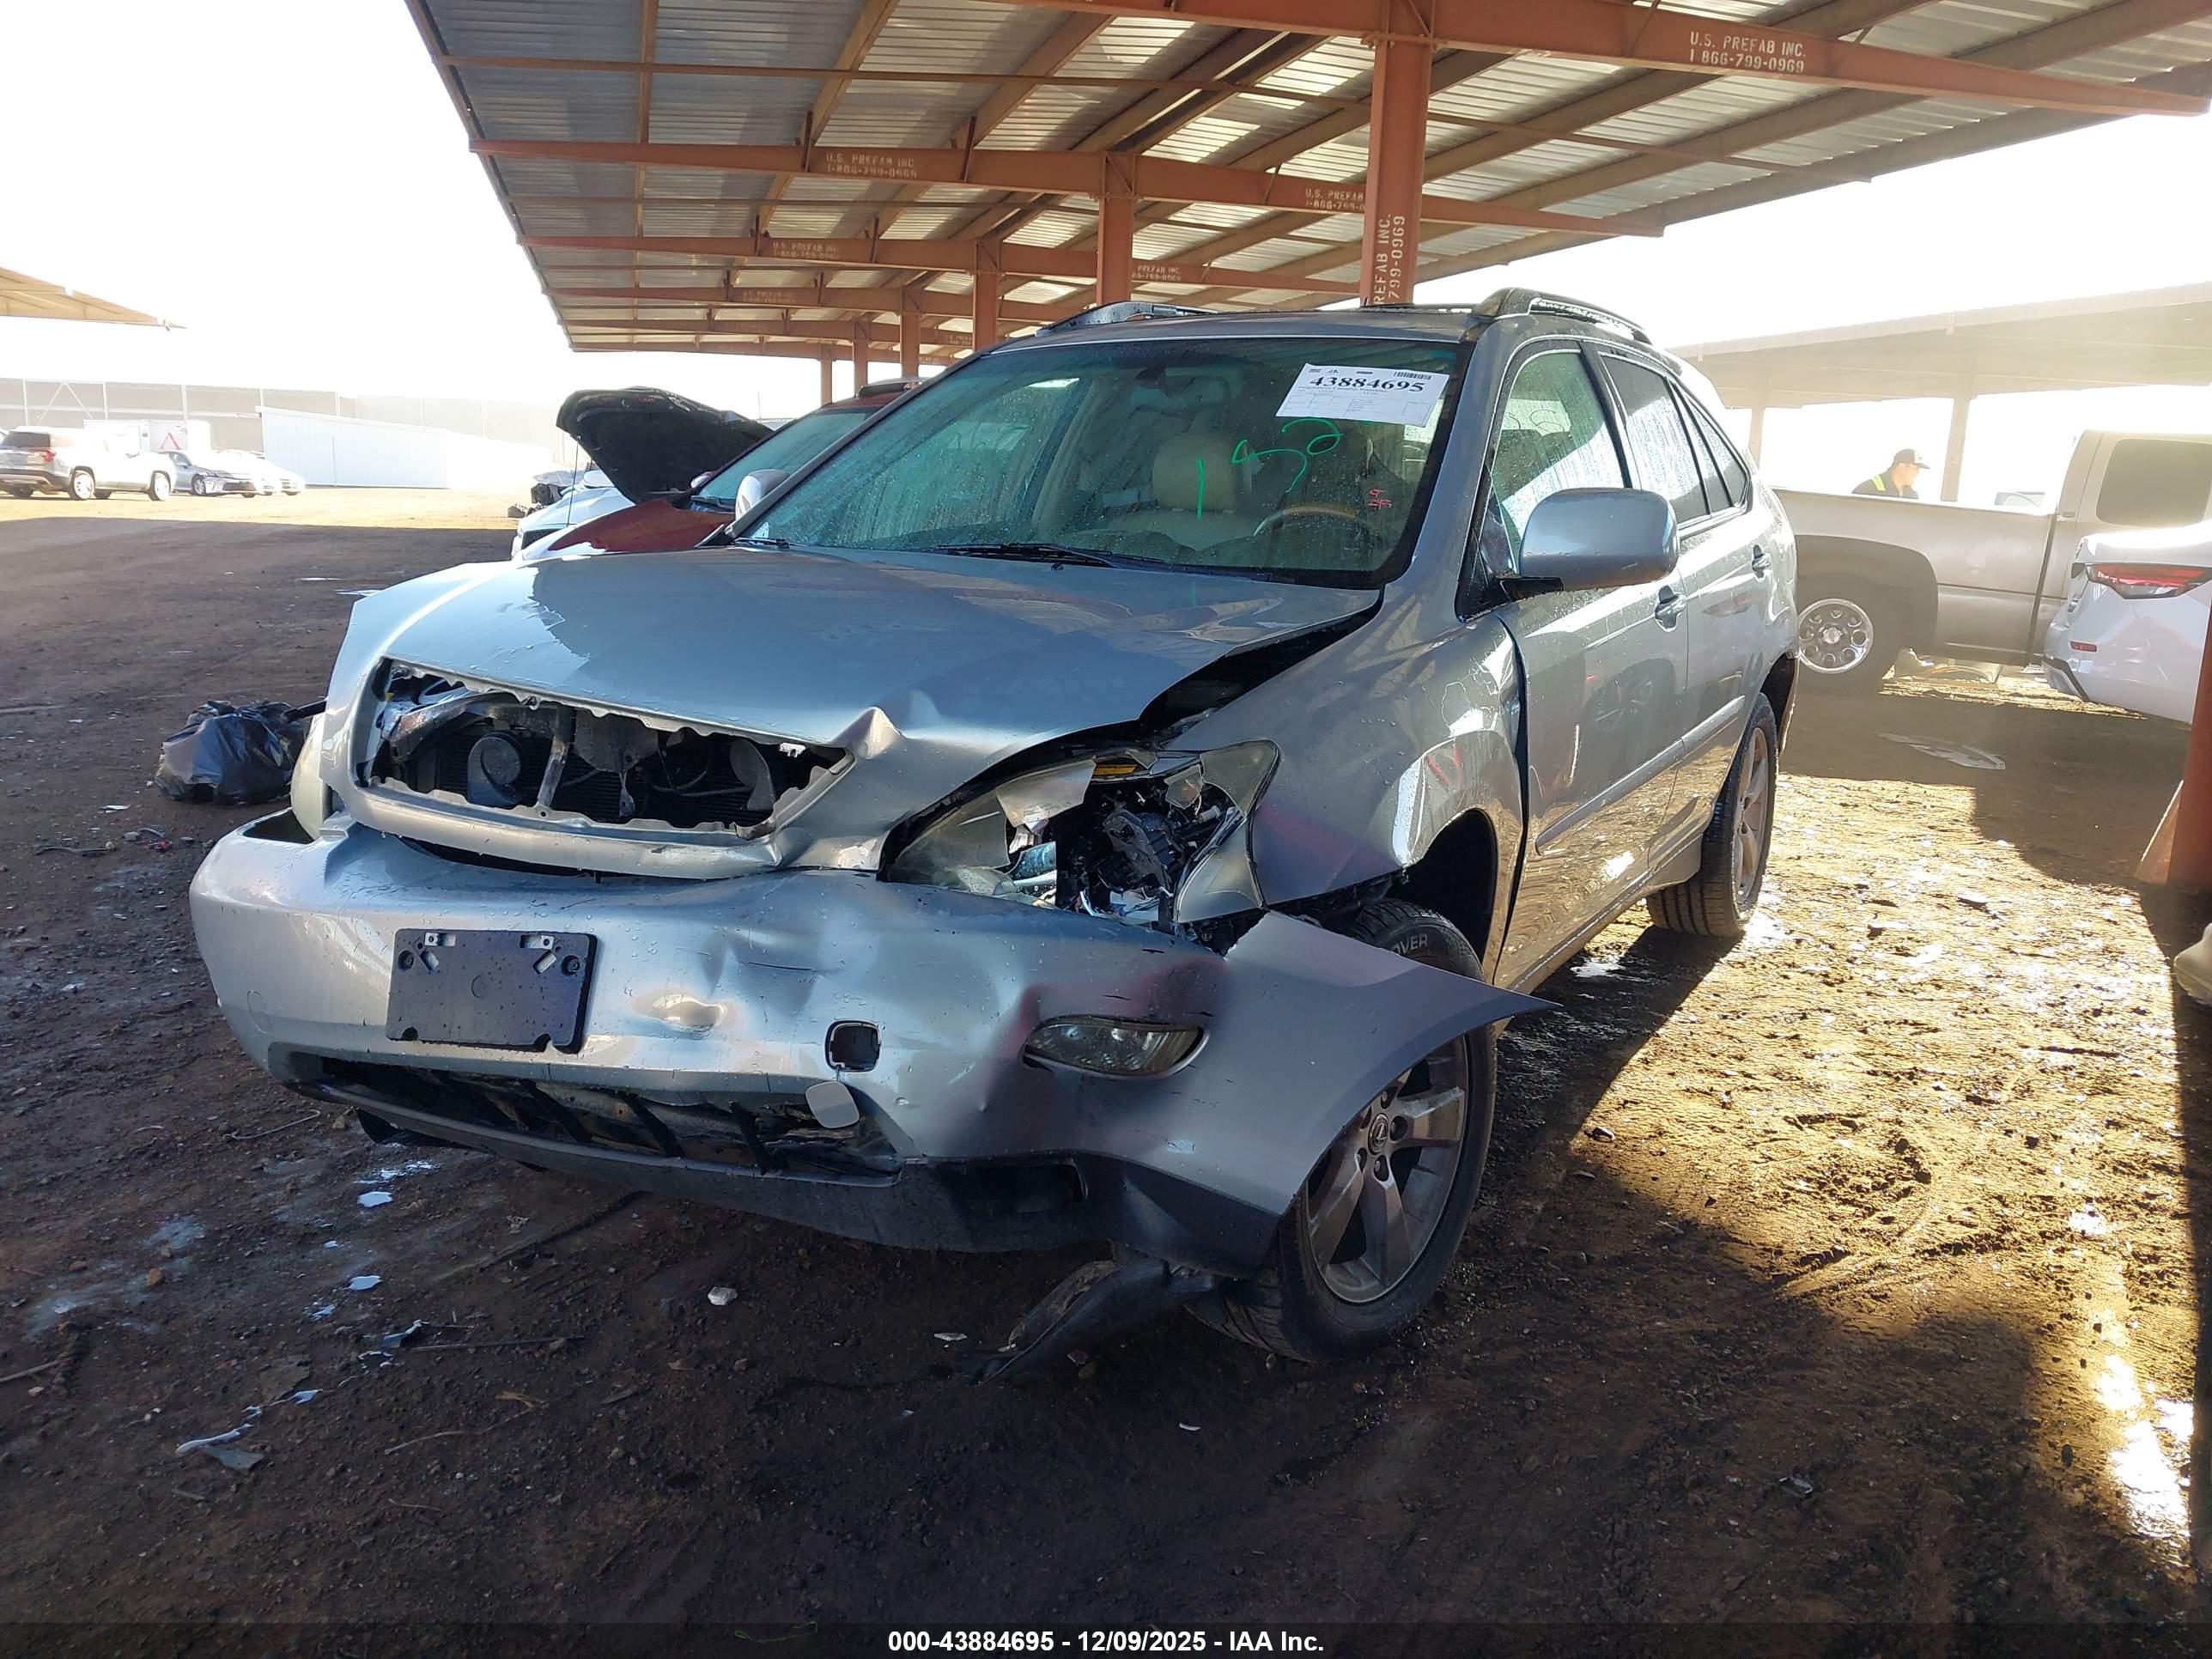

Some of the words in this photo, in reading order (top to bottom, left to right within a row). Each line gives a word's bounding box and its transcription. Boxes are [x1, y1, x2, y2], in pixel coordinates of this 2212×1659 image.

[1690, 31, 1716, 48] U.S.
[1723, 35, 1776, 54] PREFAB
[1782, 41, 1806, 58] INC.
[851, 155, 893, 166] PREFAB
[1377, 214, 1391, 244] INC.
[1388, 216, 1406, 304] 799-0969
[1310, 376, 1425, 392] 43884695
